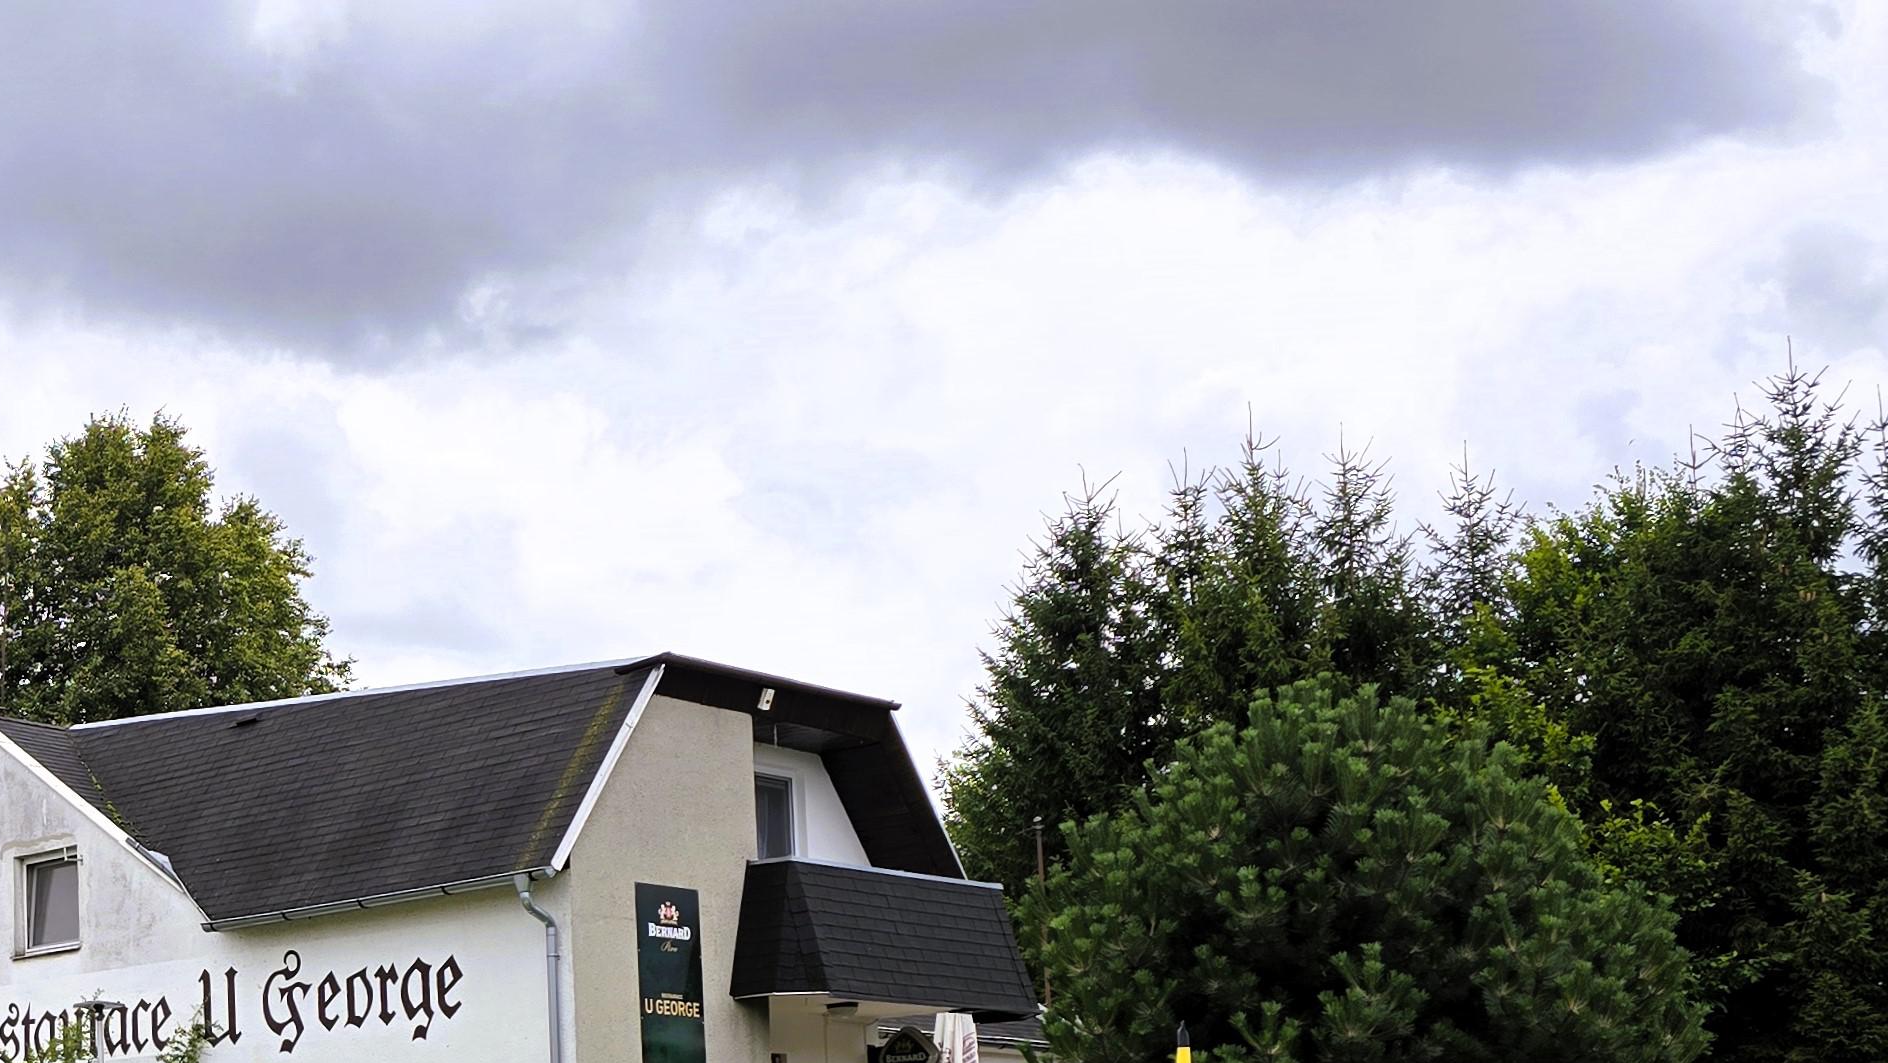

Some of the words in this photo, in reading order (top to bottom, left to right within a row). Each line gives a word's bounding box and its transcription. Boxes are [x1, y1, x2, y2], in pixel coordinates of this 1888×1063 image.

[648, 922, 691, 941] BERNARD
[198, 965, 243, 1048] U
[262, 949, 464, 1054] George
[644, 998, 654, 1014] U
[655, 999, 701, 1018] GEORGE
